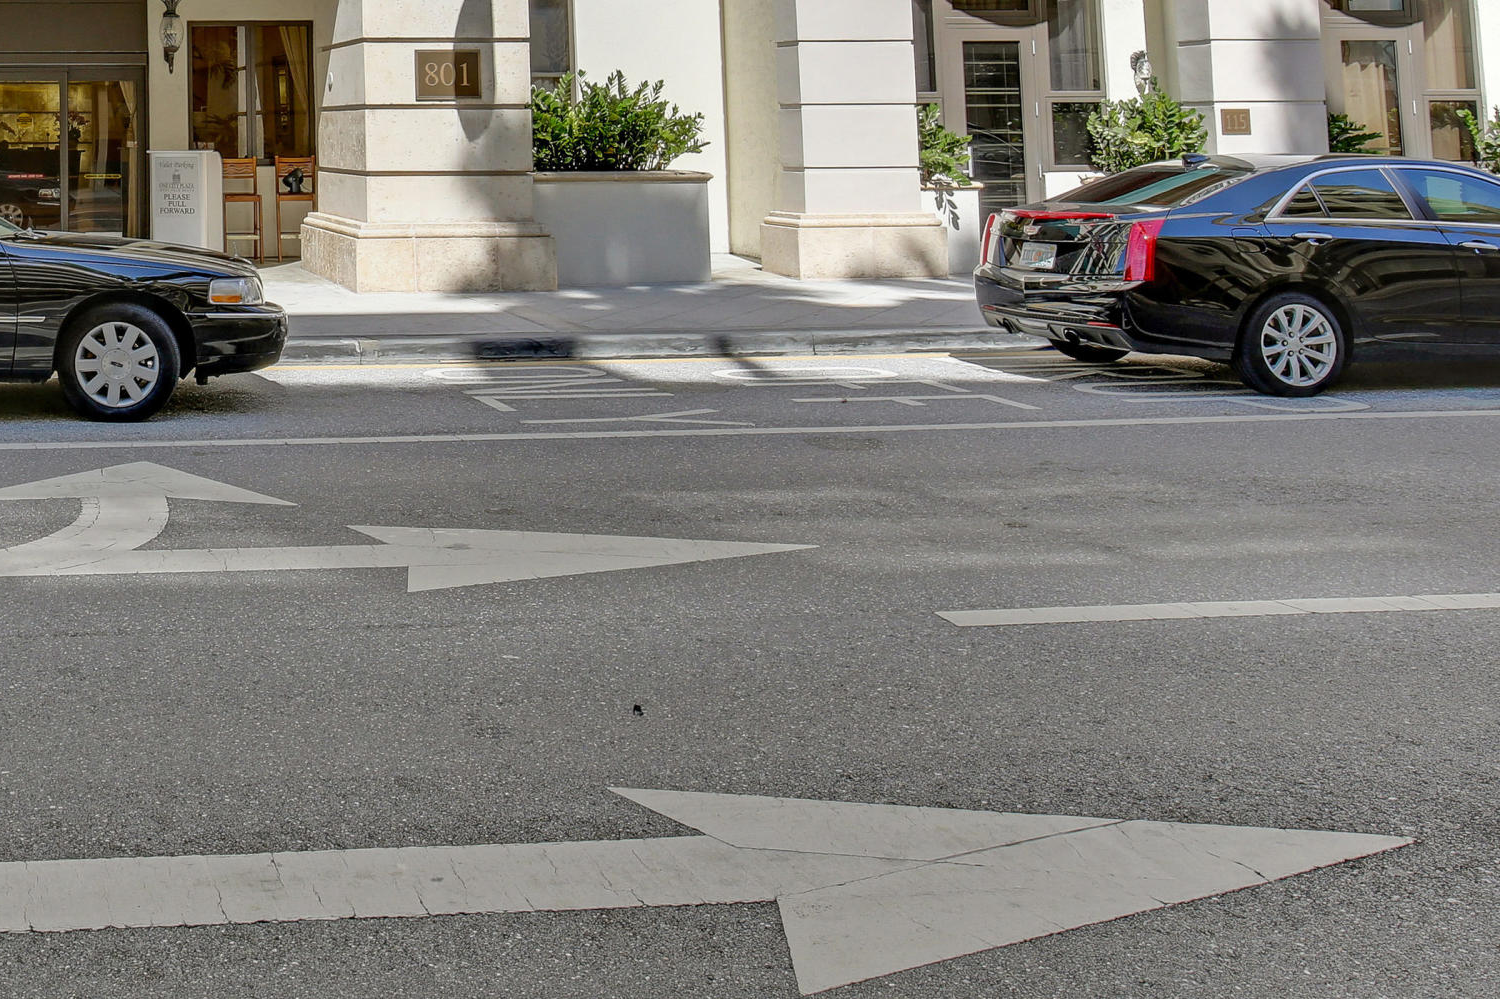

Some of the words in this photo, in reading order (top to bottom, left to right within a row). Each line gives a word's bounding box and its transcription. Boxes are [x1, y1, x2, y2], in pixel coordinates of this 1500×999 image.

[425, 62, 470, 86] 801
[1226, 112, 1246, 129] 115
[163, 193, 191, 201] PLEASE
[159, 207, 195, 215] FORWARD
[423, 366, 755, 427] ONLY
